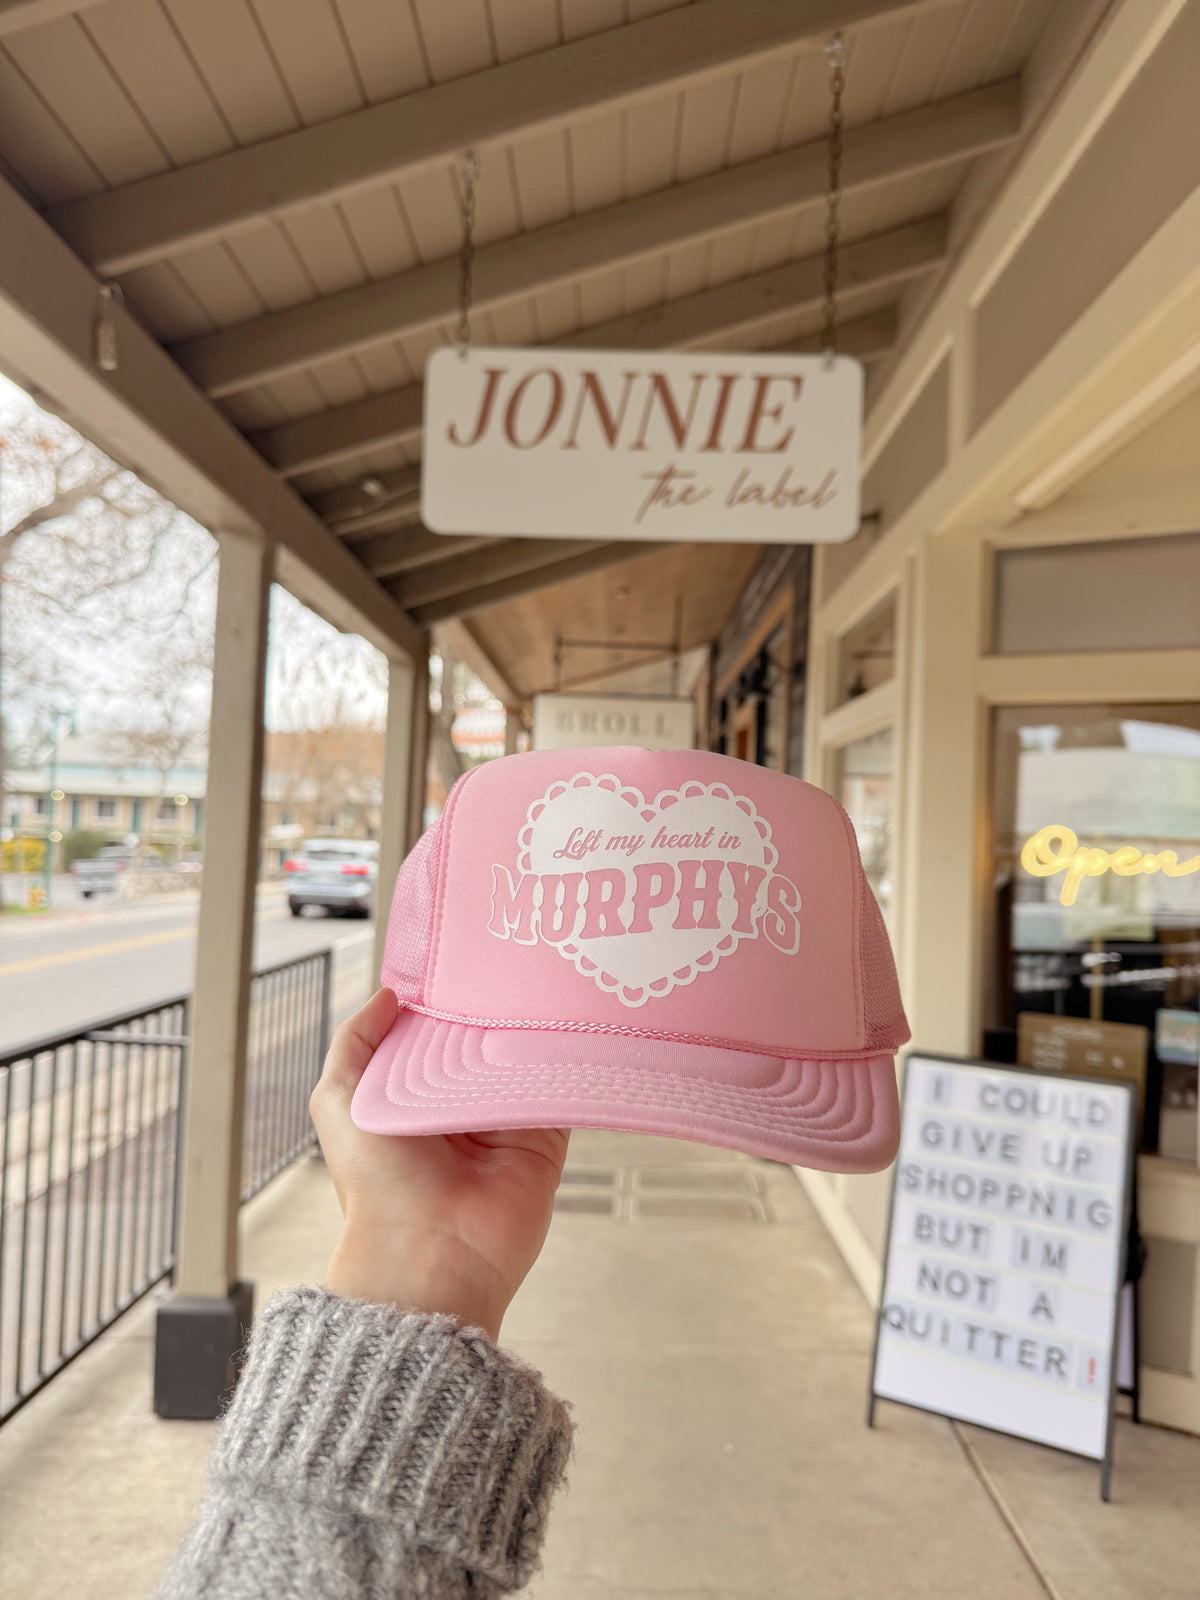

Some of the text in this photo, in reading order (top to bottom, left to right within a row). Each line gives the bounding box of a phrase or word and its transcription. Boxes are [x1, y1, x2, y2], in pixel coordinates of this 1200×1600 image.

[447, 366, 804, 454] JONNIE
[634, 463, 839, 525] the label
[553, 826, 742, 860] Left my heart in
[1021, 825, 1200, 906] Open
[488, 860, 802, 956] MURPHYS
[979, 1082, 1113, 1127] COULD
[920, 1120, 1094, 1174] GIVE UP
[902, 1163, 1114, 1230] SHOPPNIG
[914, 1212, 989, 1251] BUT
[917, 1261, 1056, 1323] NOT A
